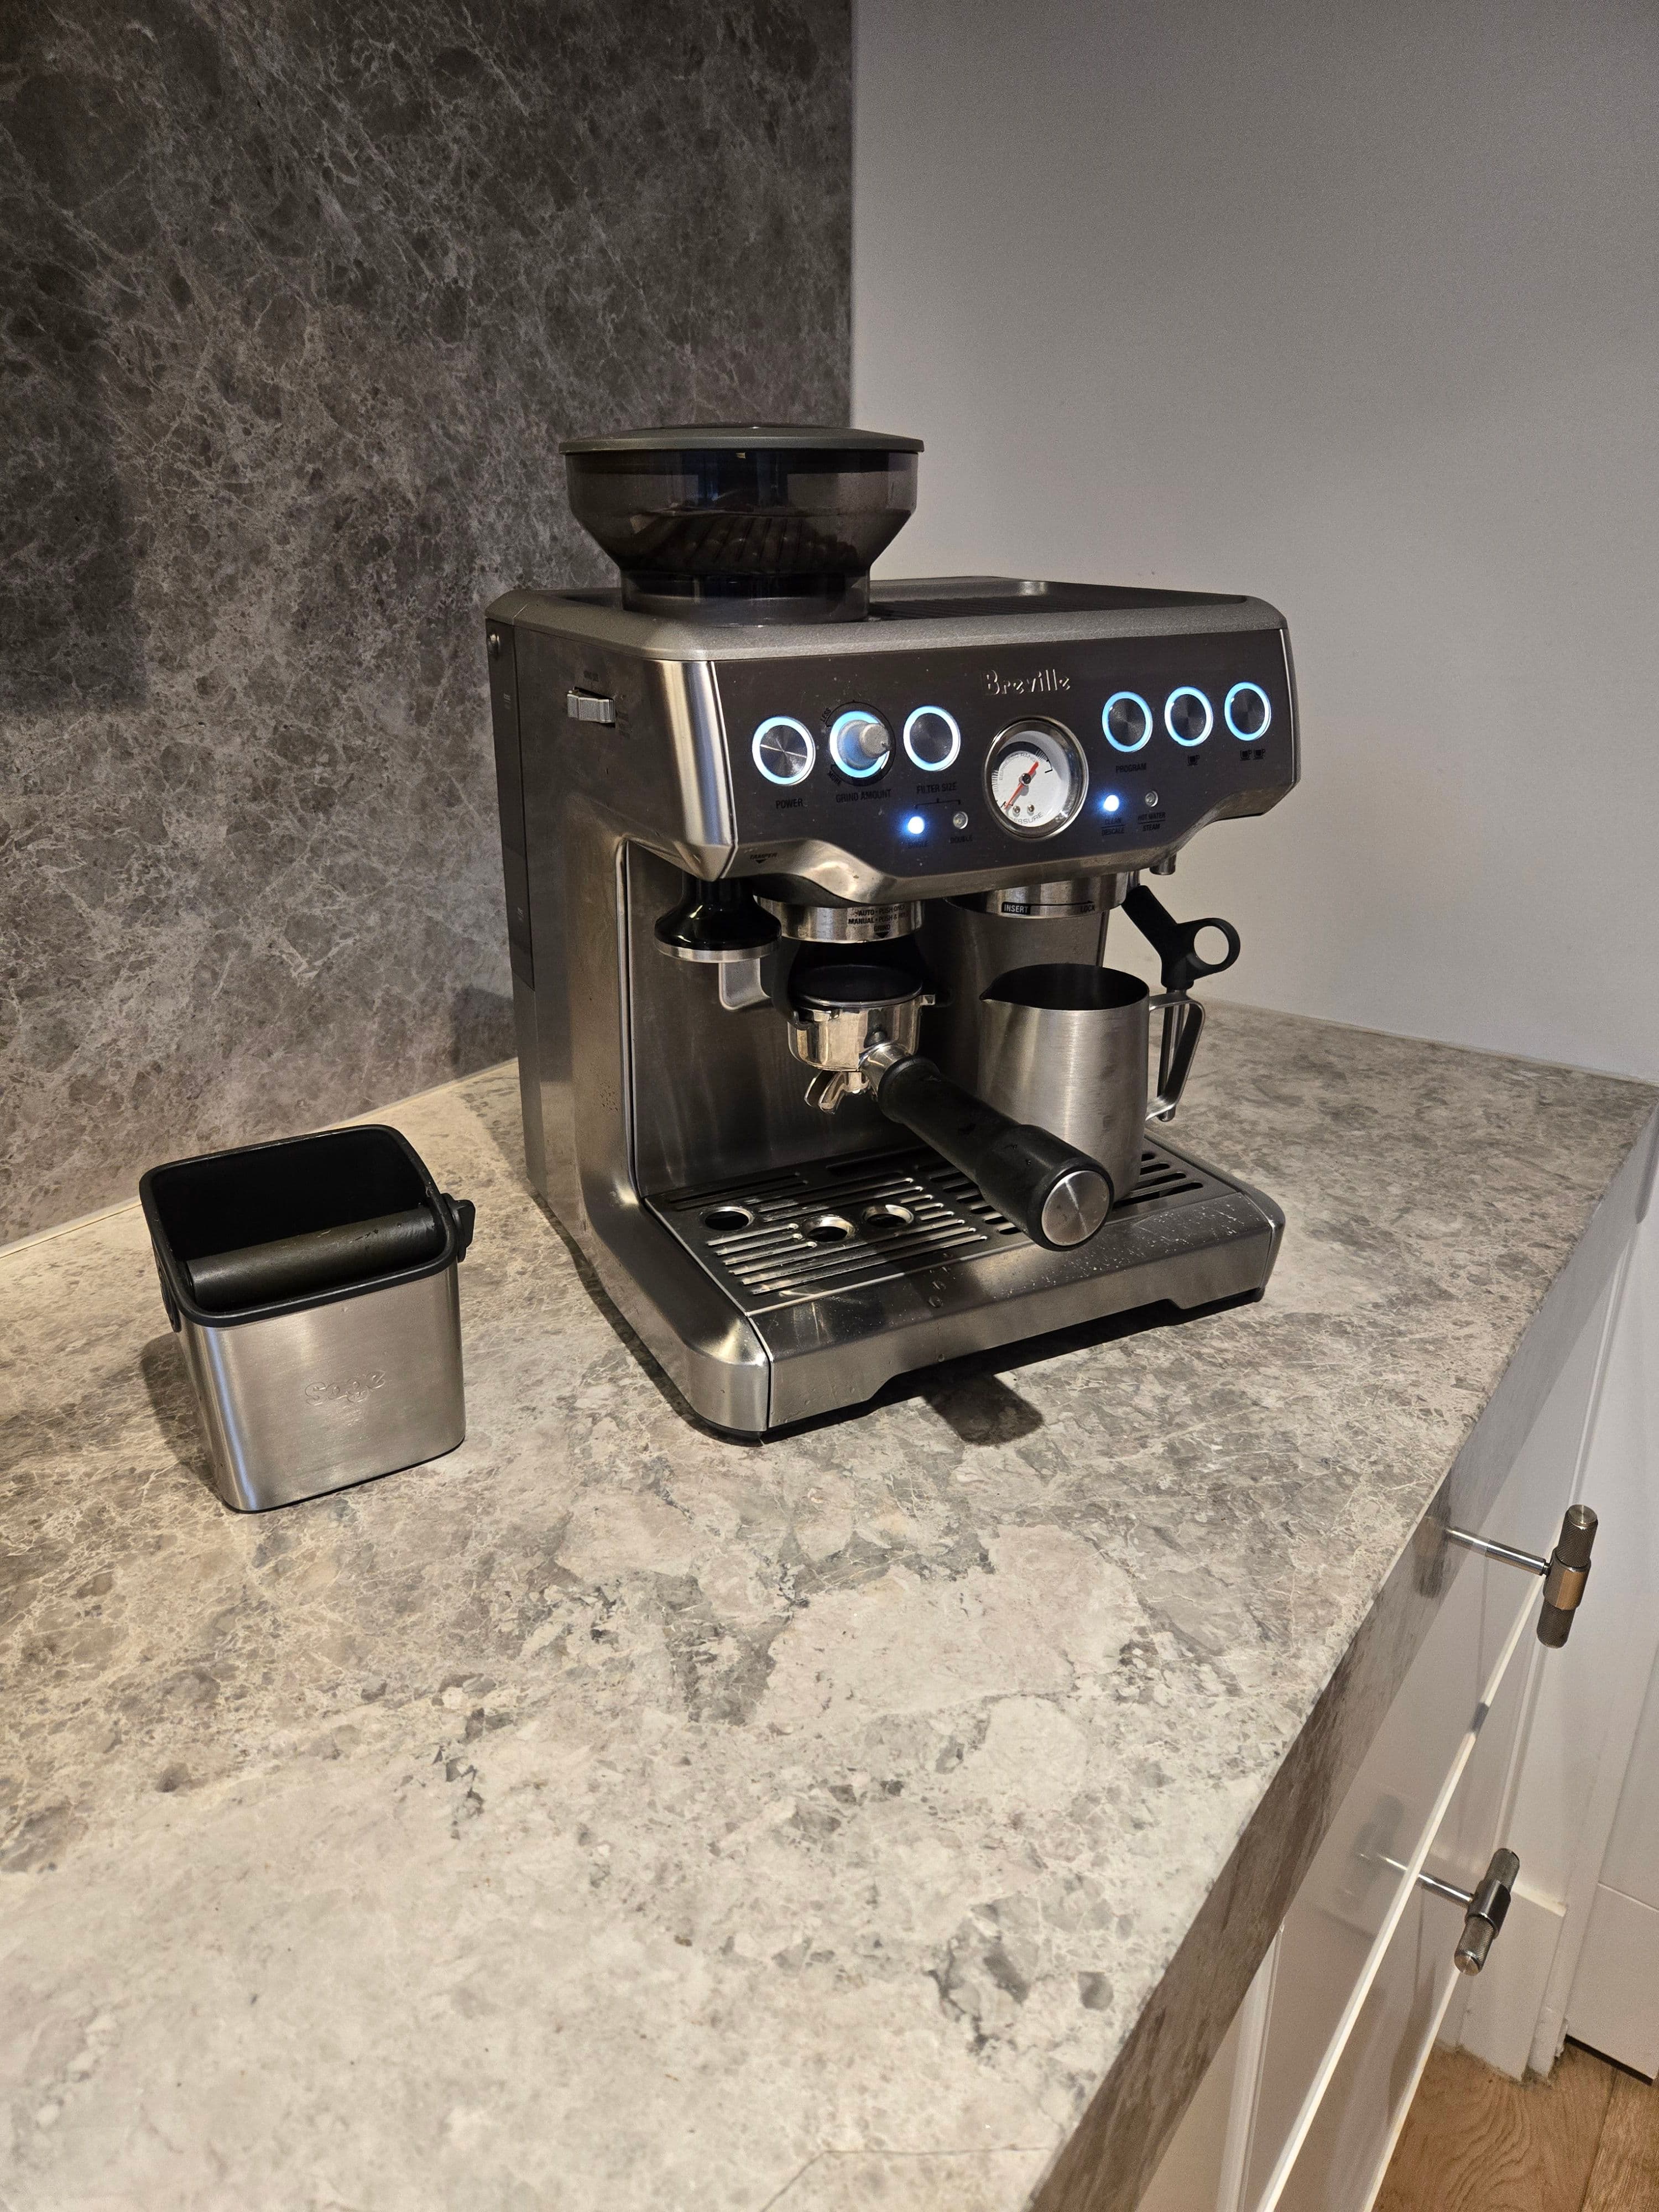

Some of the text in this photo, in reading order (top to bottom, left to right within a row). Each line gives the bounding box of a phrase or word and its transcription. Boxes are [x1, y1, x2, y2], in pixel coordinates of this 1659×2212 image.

[983, 669, 1071, 695] Breville
[1115, 763, 1146, 773] PROGRAM
[916, 781, 957, 795] FILTER SIZE
[836, 789, 891, 804] GRIND AMOUNT
[776, 798, 804, 809] POWER
[1149, 812, 1166, 820] WATER
[1142, 823, 1161, 832] STEAM
[1004, 904, 1028, 914] INSERT
[1080, 904, 1095, 913] LOCK
[878, 915, 893, 923] PUSH
[873, 924, 891, 932] GRIND
